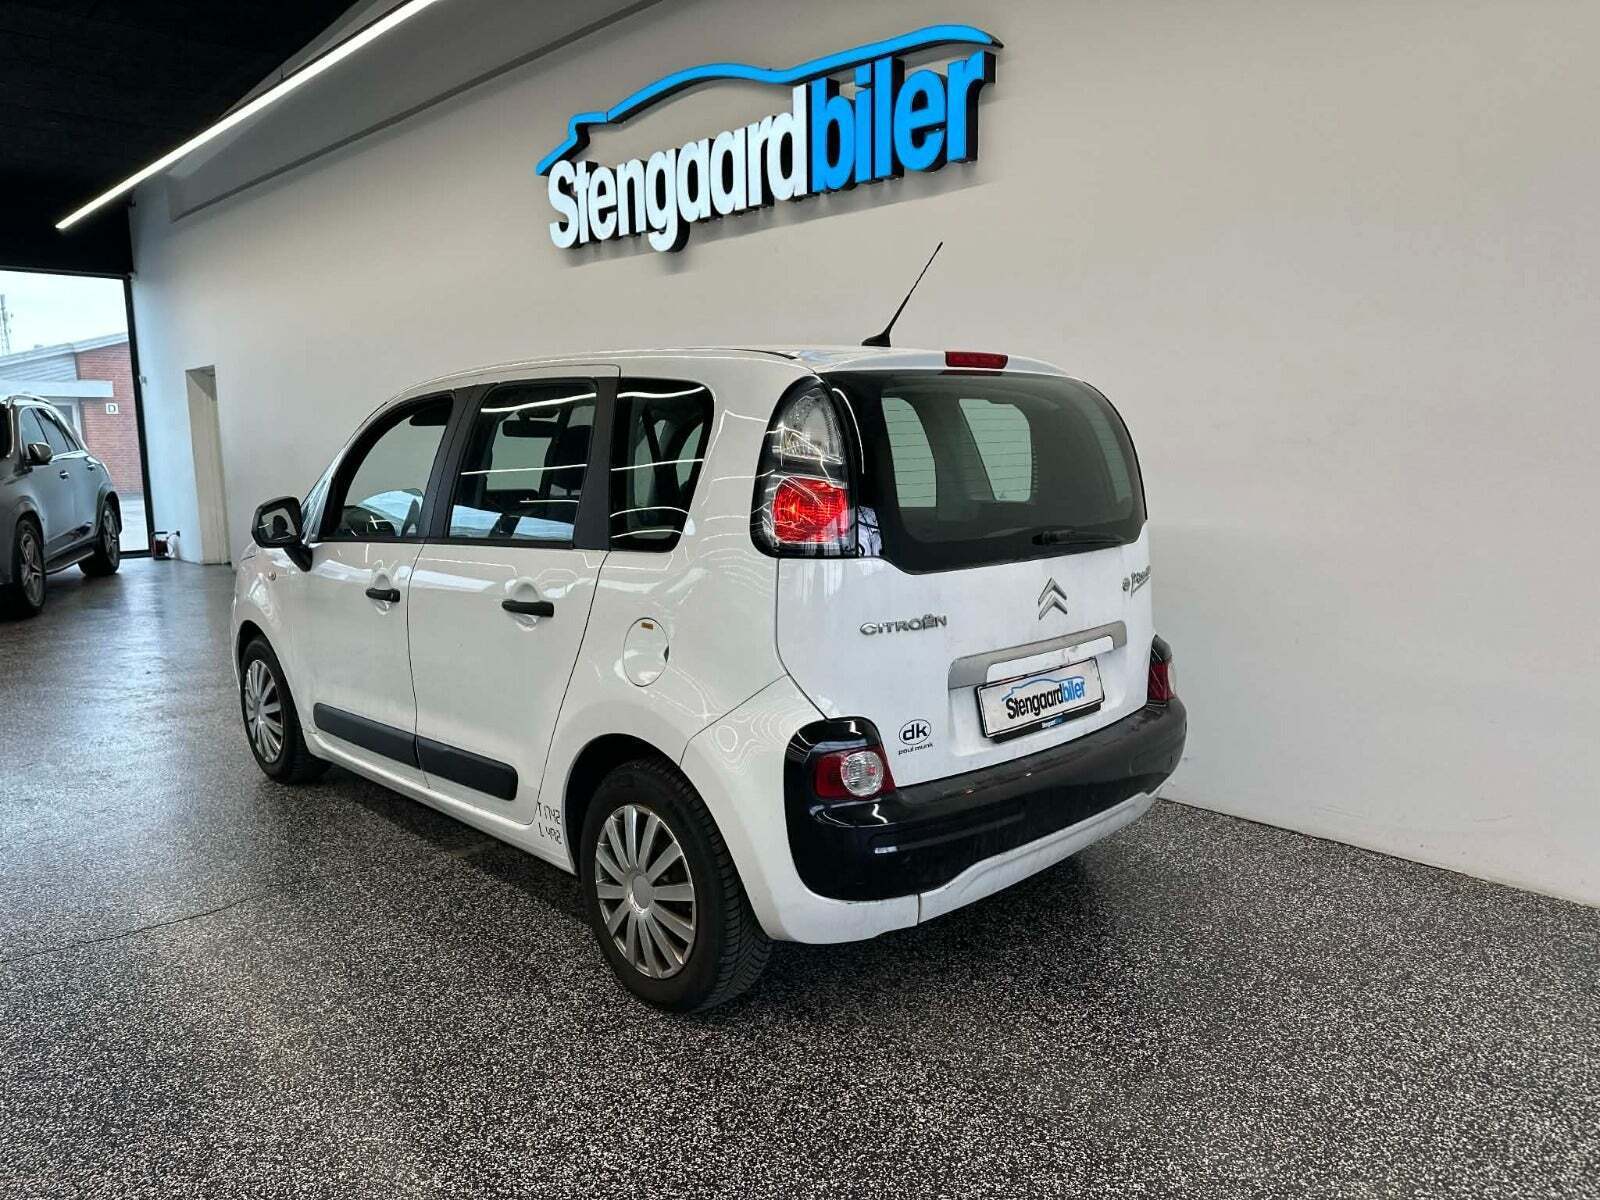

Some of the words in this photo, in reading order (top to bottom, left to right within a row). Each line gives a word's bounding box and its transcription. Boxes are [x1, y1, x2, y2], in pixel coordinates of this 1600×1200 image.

[548, 50, 992, 251] Stengaardbiler
[860, 613, 947, 635] CITROËN
[1005, 681, 1086, 719] Stengaardbiler
[903, 723, 928, 741] dk
